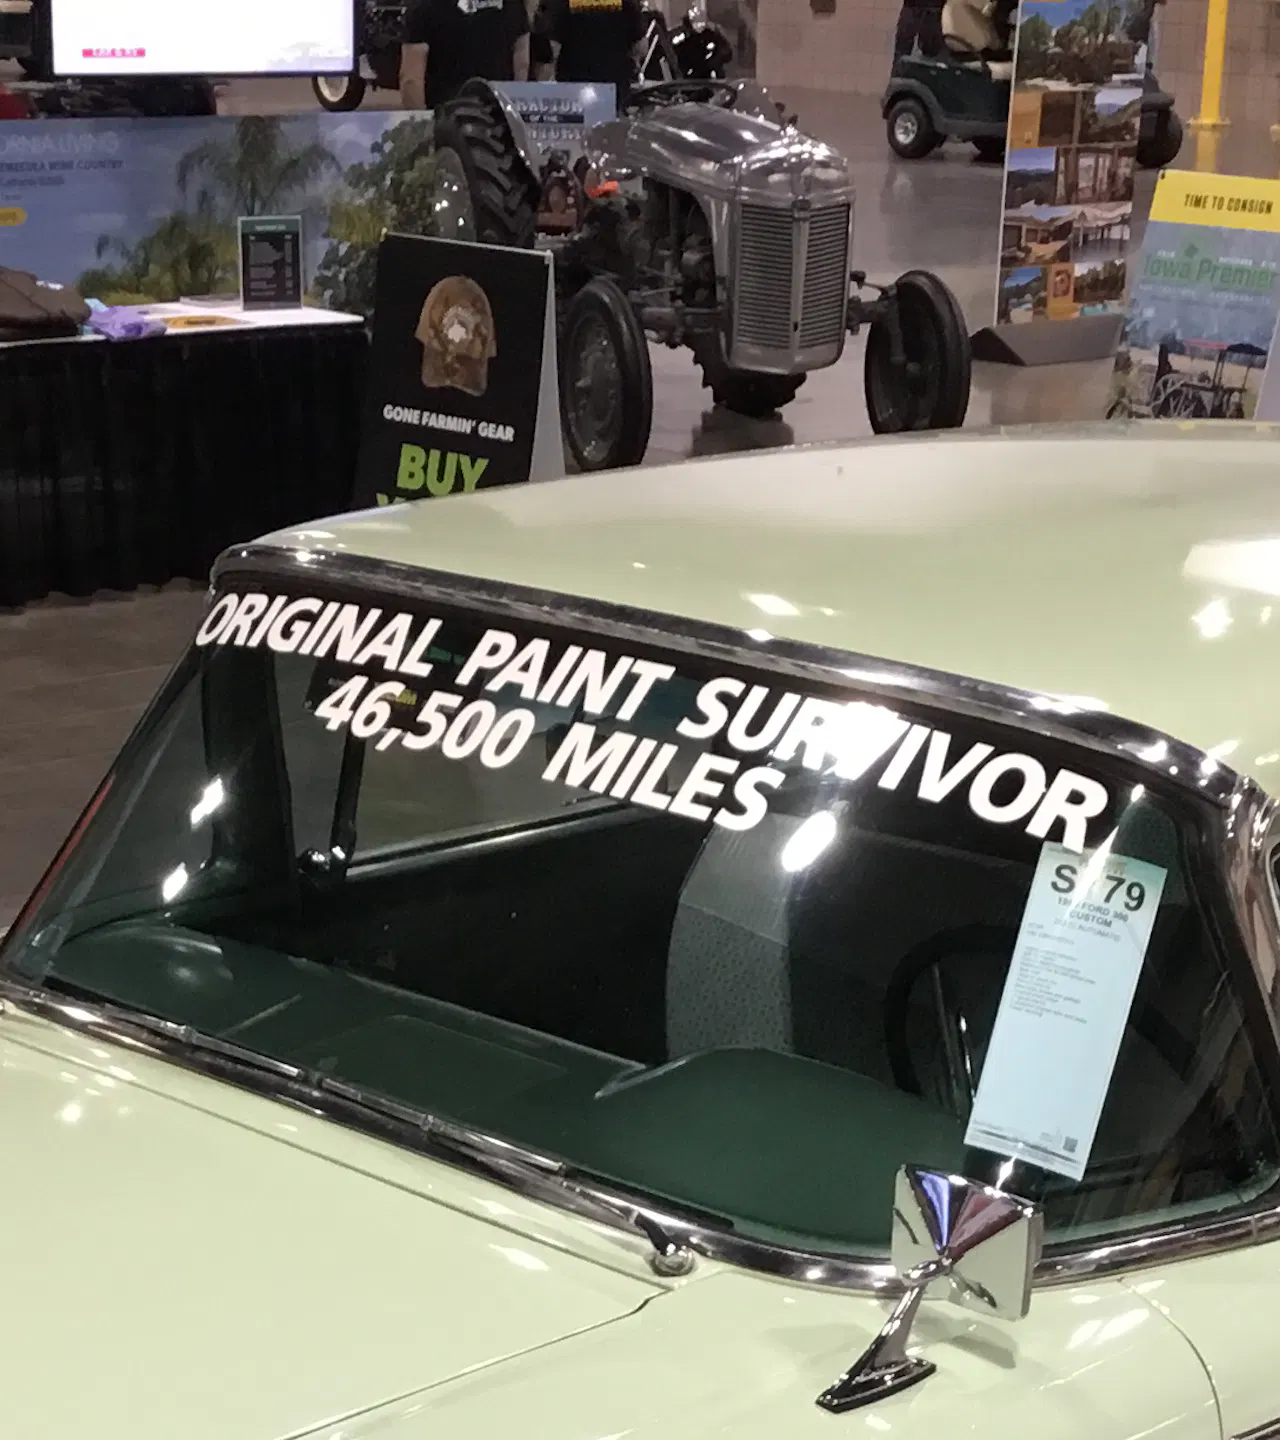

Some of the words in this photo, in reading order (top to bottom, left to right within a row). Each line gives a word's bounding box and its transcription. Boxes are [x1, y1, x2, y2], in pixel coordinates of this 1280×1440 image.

[58, 131, 120, 155] LIVING
[1184, 193, 1209, 209] TIME
[1211, 195, 1225, 211] TO
[1226, 197, 1273, 215] CONSIGN
[1143, 254, 1191, 279] Iowa
[1196, 257, 1280, 290] Premier
[382, 404, 420, 425] GONE
[421, 411, 477, 434] FARMIN'
[478, 422, 515, 442] GEAR
[396, 443, 490, 496] BUY
[196, 593, 443, 677] ORIGINAL
[455, 629, 676, 721] PAINT
[676, 677, 1108, 854] SURVIVOR
[314, 675, 536, 769] 46,500
[541, 721, 786, 832] MILES
[1051, 864, 1146, 912] S79
[1070, 910, 1113, 928] CUSTOM
[1081, 902, 1111, 917] FORD
